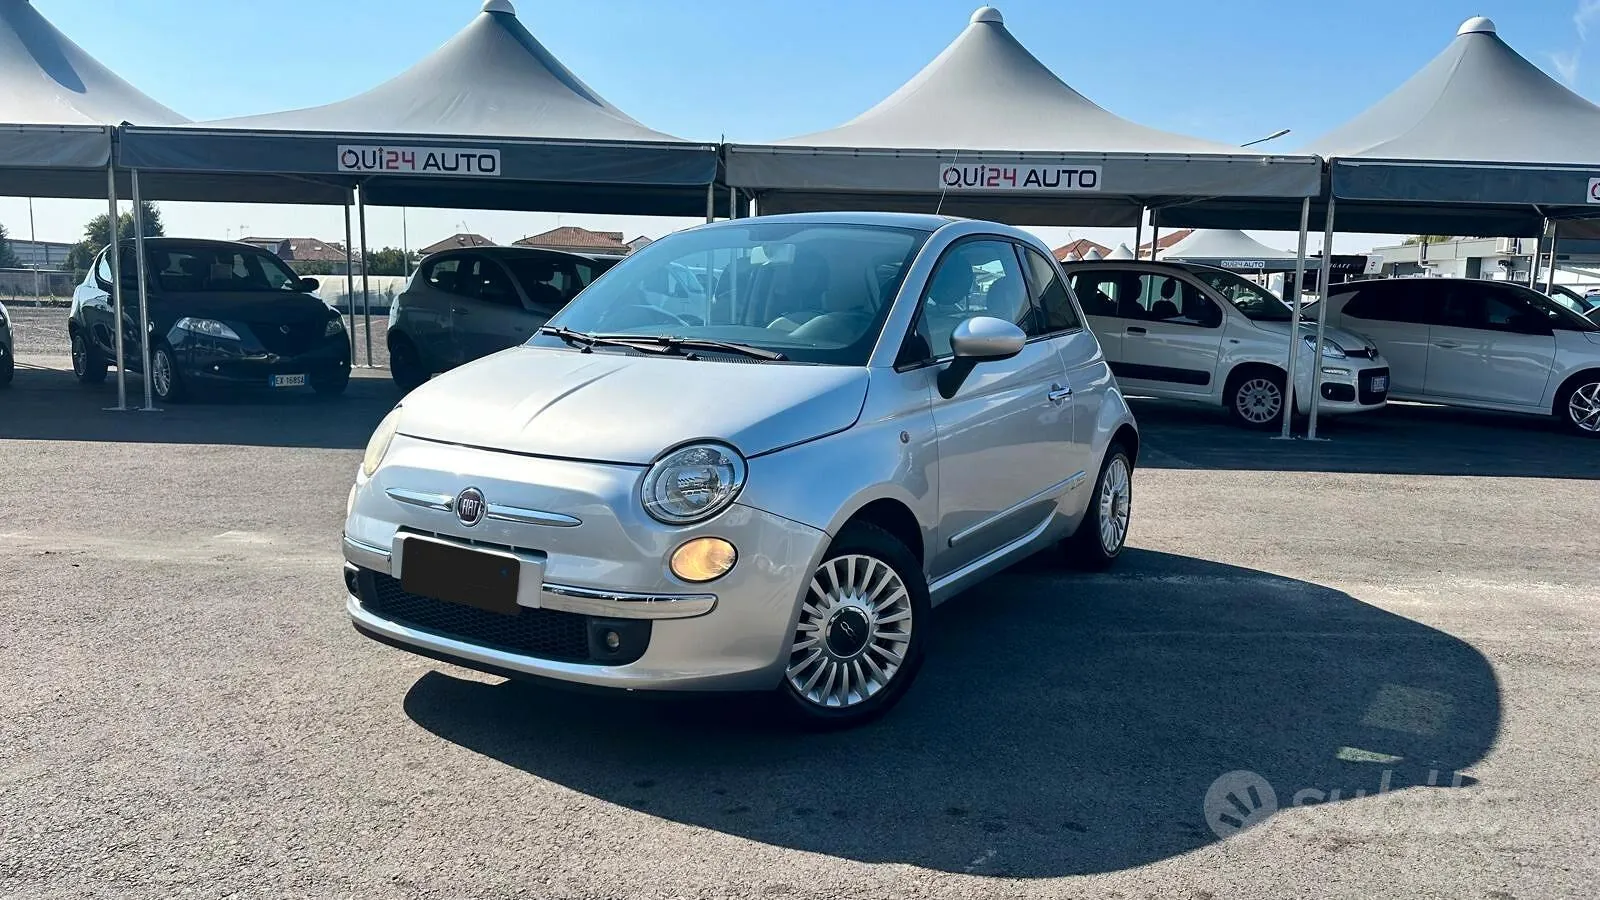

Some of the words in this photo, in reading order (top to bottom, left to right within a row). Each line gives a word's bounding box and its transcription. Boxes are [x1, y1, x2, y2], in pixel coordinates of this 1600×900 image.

[422, 152, 496, 172] AUTO
[1023, 169, 1097, 188] AUTO
[462, 498, 479, 516] FIAT
